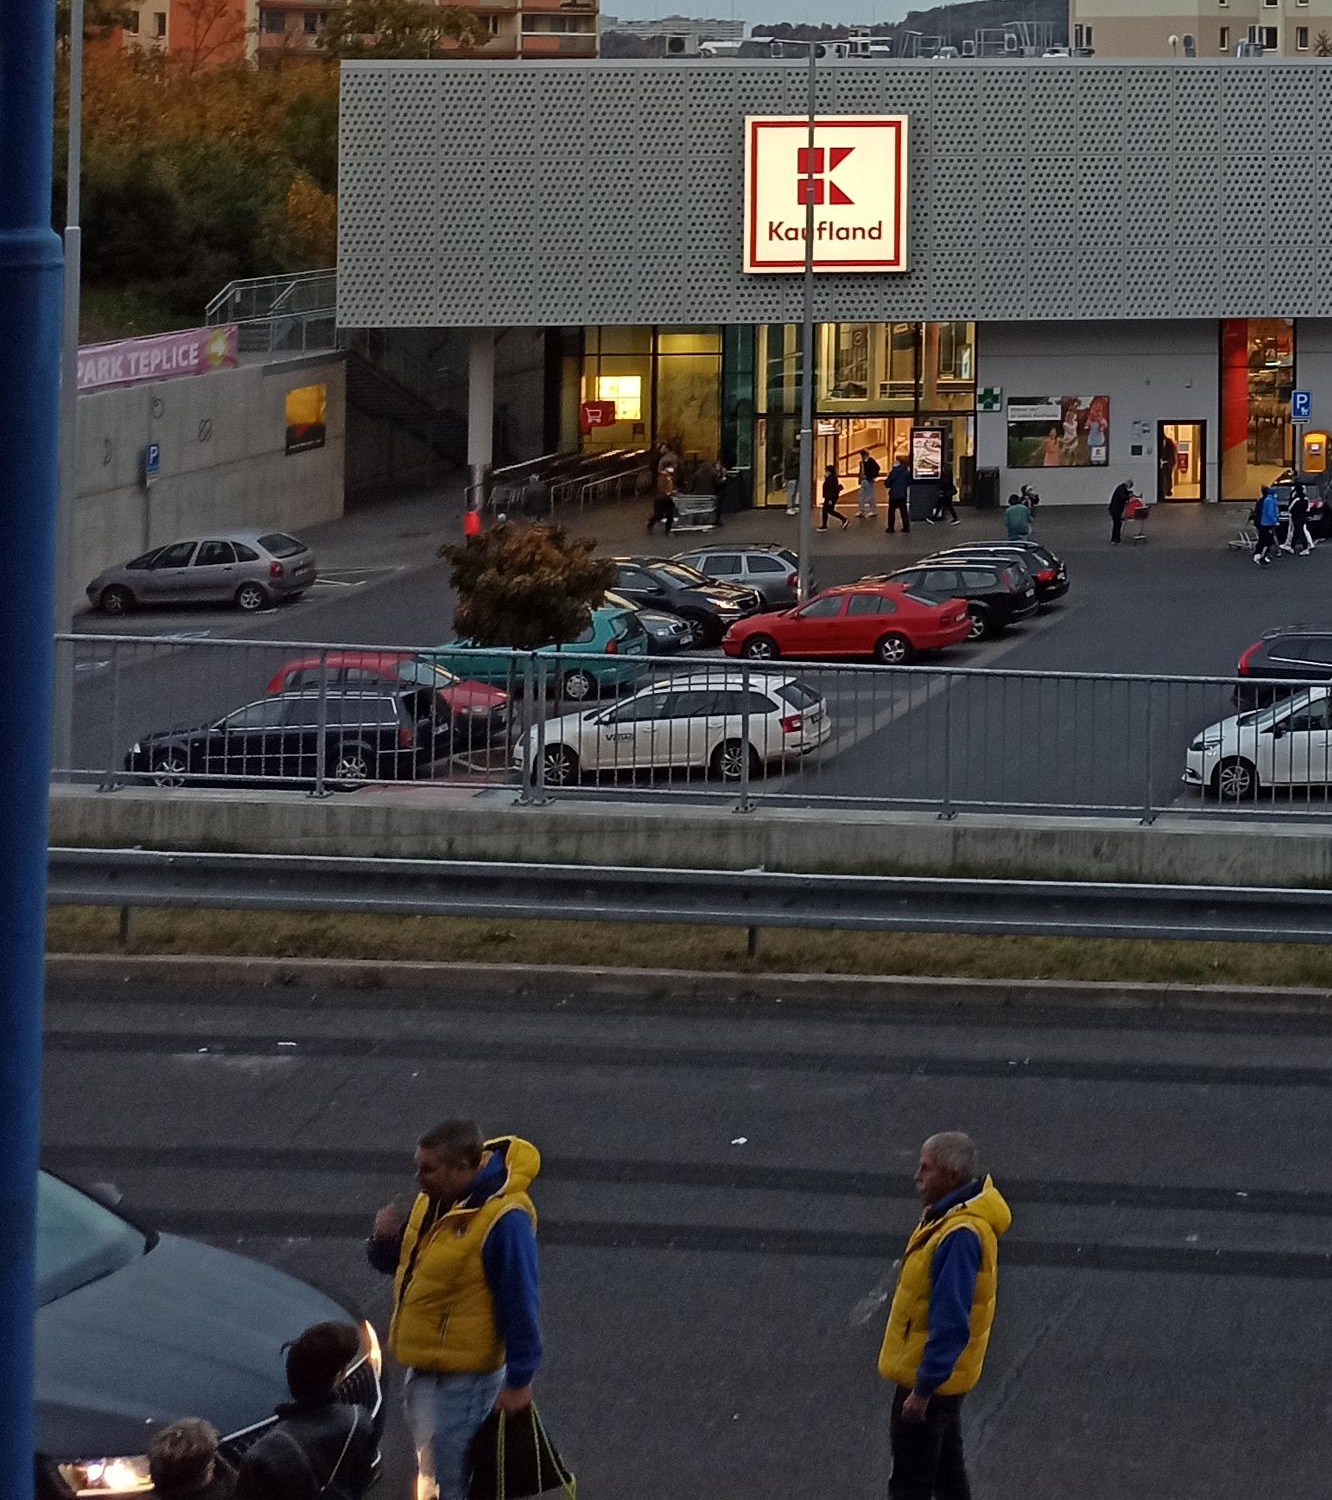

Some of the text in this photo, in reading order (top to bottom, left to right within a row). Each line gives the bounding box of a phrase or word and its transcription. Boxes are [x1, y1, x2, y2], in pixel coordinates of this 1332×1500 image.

[128, 343, 200, 375] TEPLICE
[1296, 393, 1308, 409] P
[149, 445, 158, 464] P
